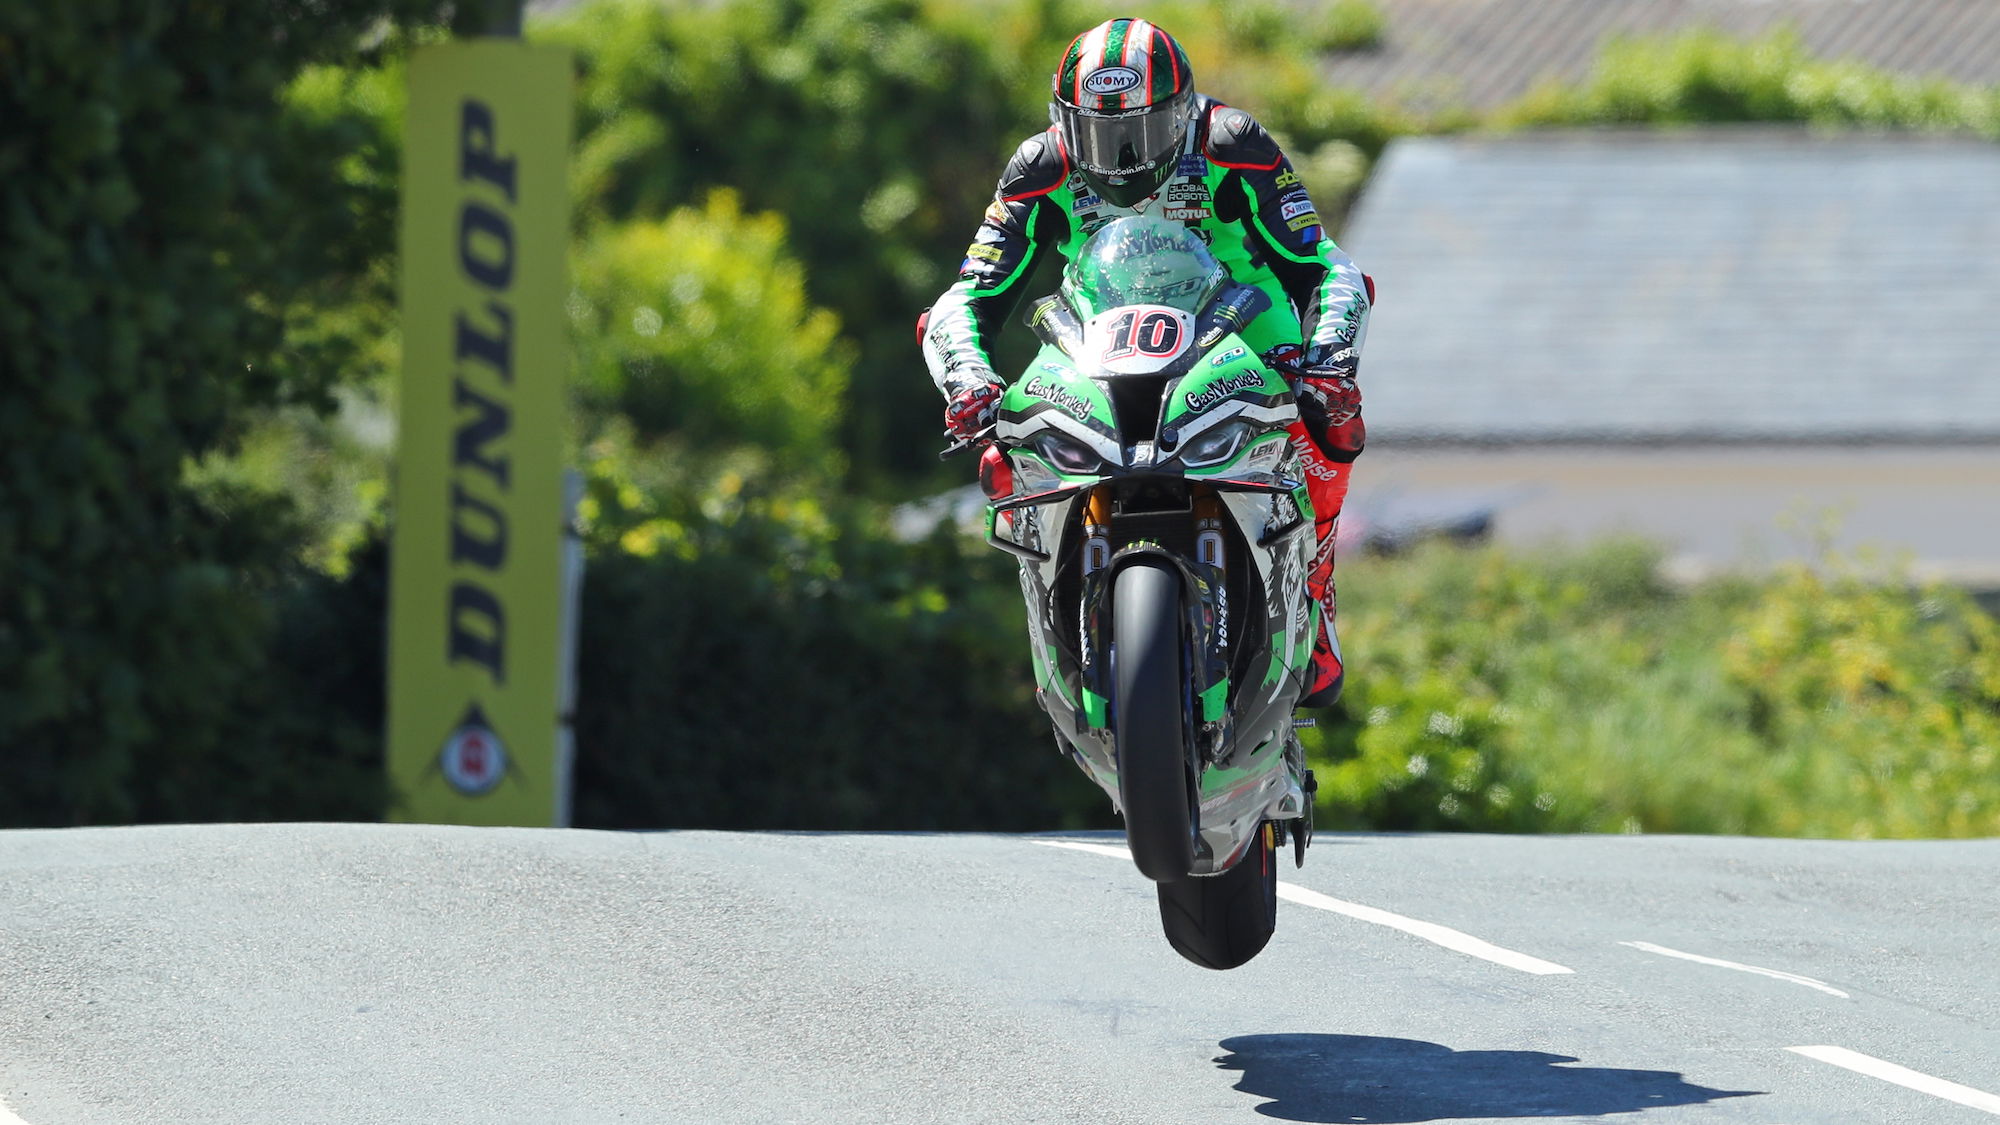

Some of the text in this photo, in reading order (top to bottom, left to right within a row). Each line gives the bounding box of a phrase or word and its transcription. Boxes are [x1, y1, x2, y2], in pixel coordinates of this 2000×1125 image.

[1089, 76, 1135, 87] SUOMY
[1088, 164, 1146, 176] CasinoCoin.im
[1169, 185, 1207, 193] GLOBAL
[1169, 193, 1210, 201] ROBOTS
[1166, 208, 1210, 219] MOTUL
[1105, 312, 1180, 359] 10
[446, 97, 518, 690] DUNLOP
[1291, 434, 1338, 482] Weise
